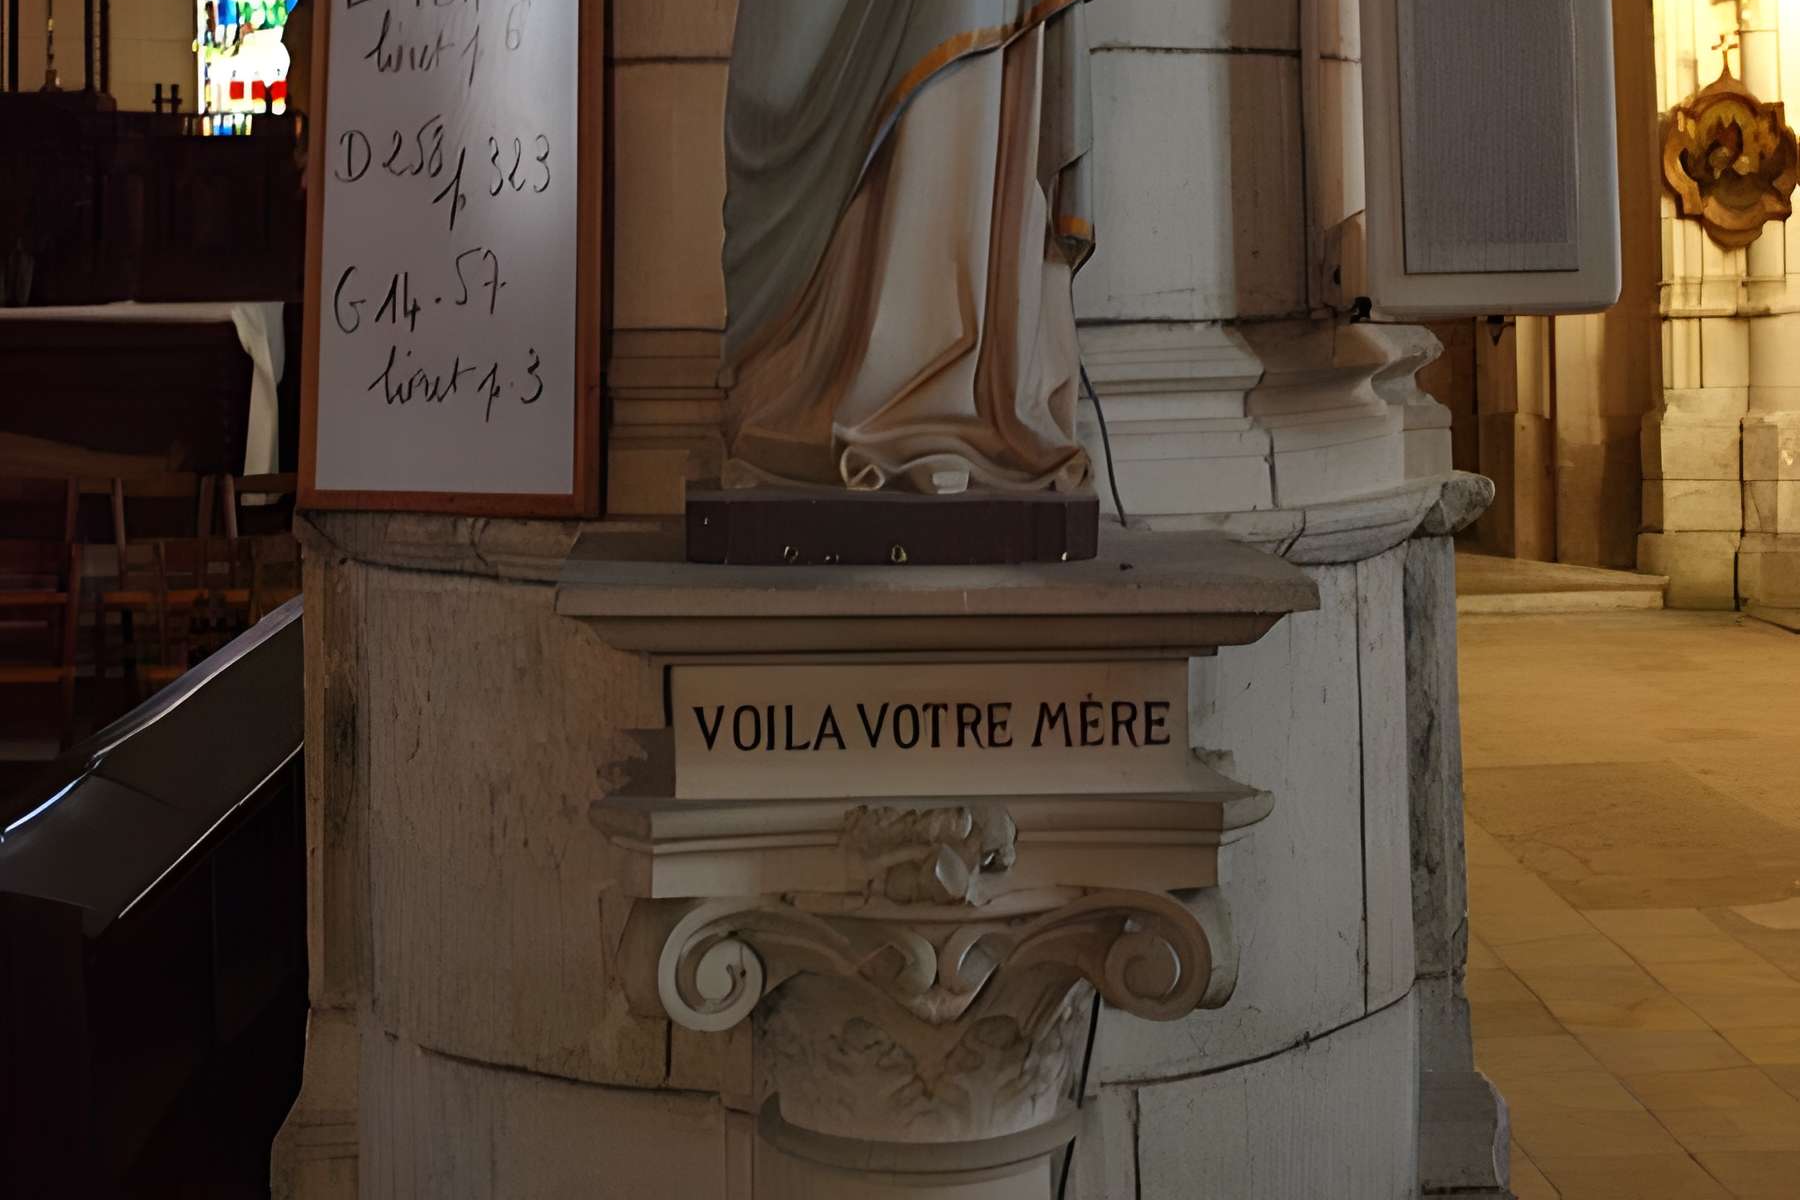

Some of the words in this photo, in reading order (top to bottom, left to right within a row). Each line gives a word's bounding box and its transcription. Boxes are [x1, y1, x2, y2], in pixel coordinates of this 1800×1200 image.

[489, 134, 551, 197] 323
[520, 348, 544, 405] 3
[692, 704, 847, 752] VOILA
[856, 702, 1013, 749] VOTRE
